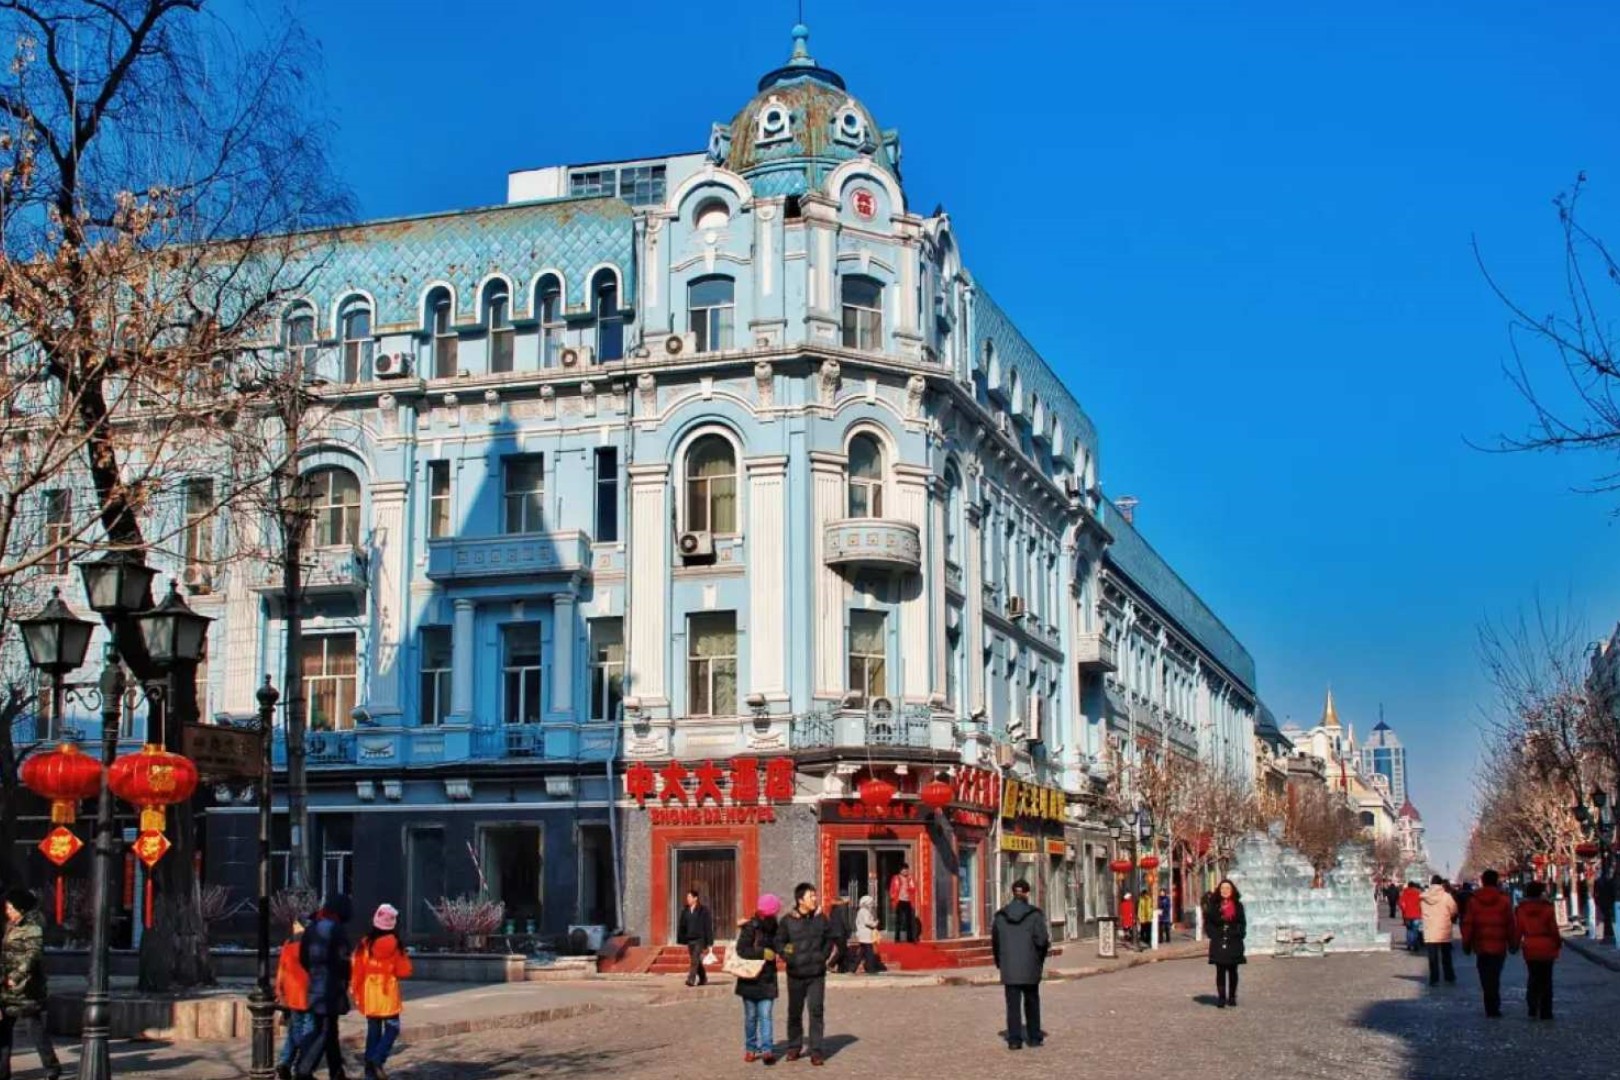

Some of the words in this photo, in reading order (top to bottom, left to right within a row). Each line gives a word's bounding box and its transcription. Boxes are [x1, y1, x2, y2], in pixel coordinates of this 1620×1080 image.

[626, 757, 795, 804] 中大大酒店
[726, 803, 775, 823] HOTEL
